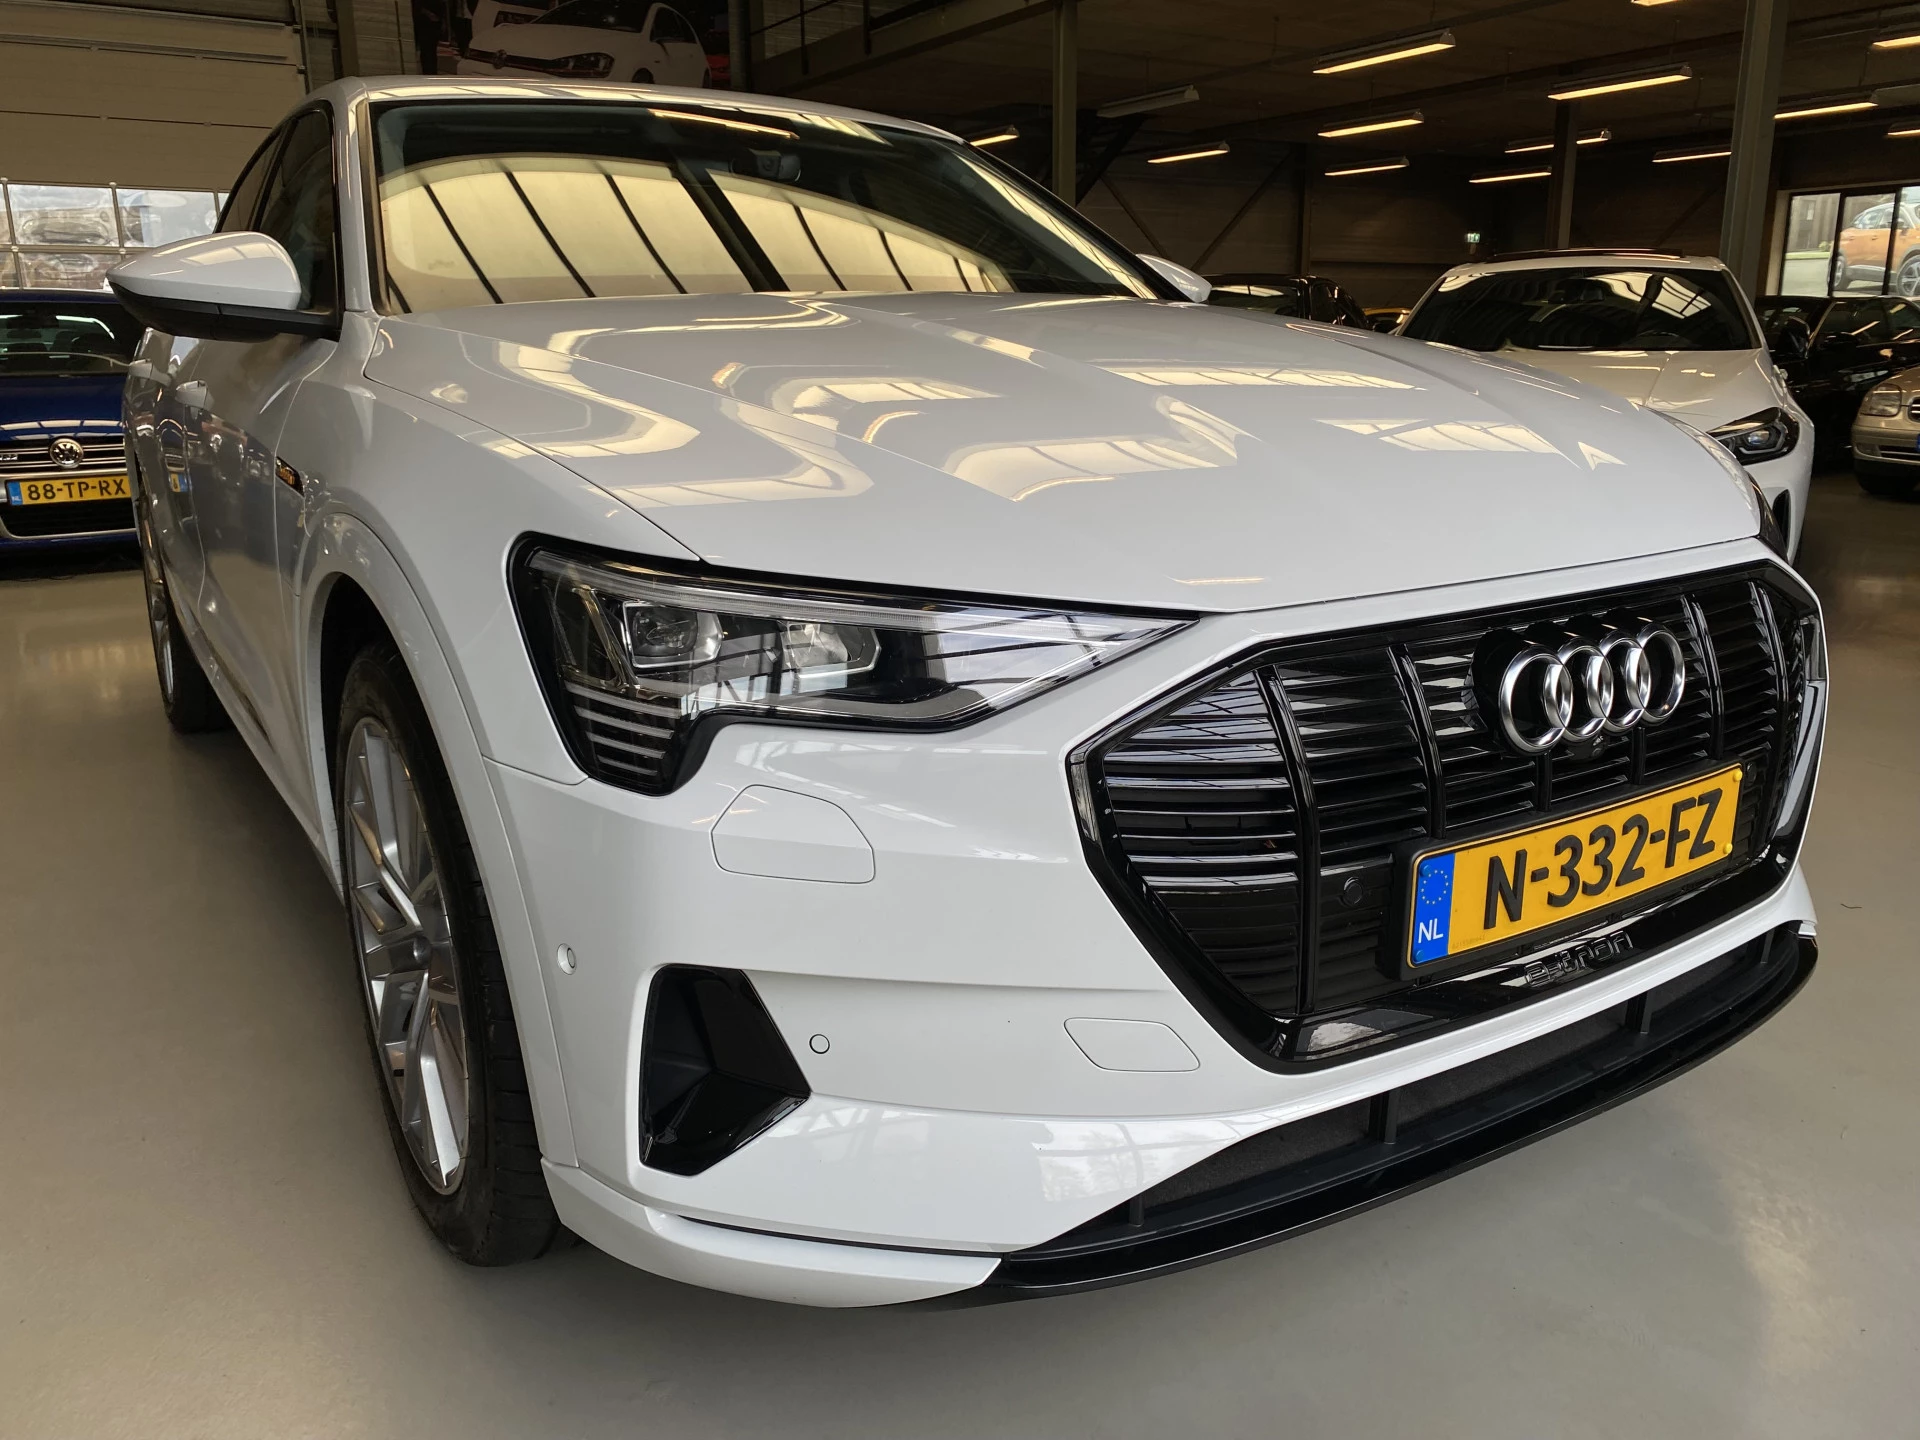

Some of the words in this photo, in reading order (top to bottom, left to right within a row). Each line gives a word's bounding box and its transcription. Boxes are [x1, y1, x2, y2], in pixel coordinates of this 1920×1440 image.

[27, 479, 126, 501] 88-TP-RX
[1483, 787, 1723, 930] N-332-FZ
[1417, 918, 1444, 944] NL
[1524, 930, 1634, 988] e-tron
